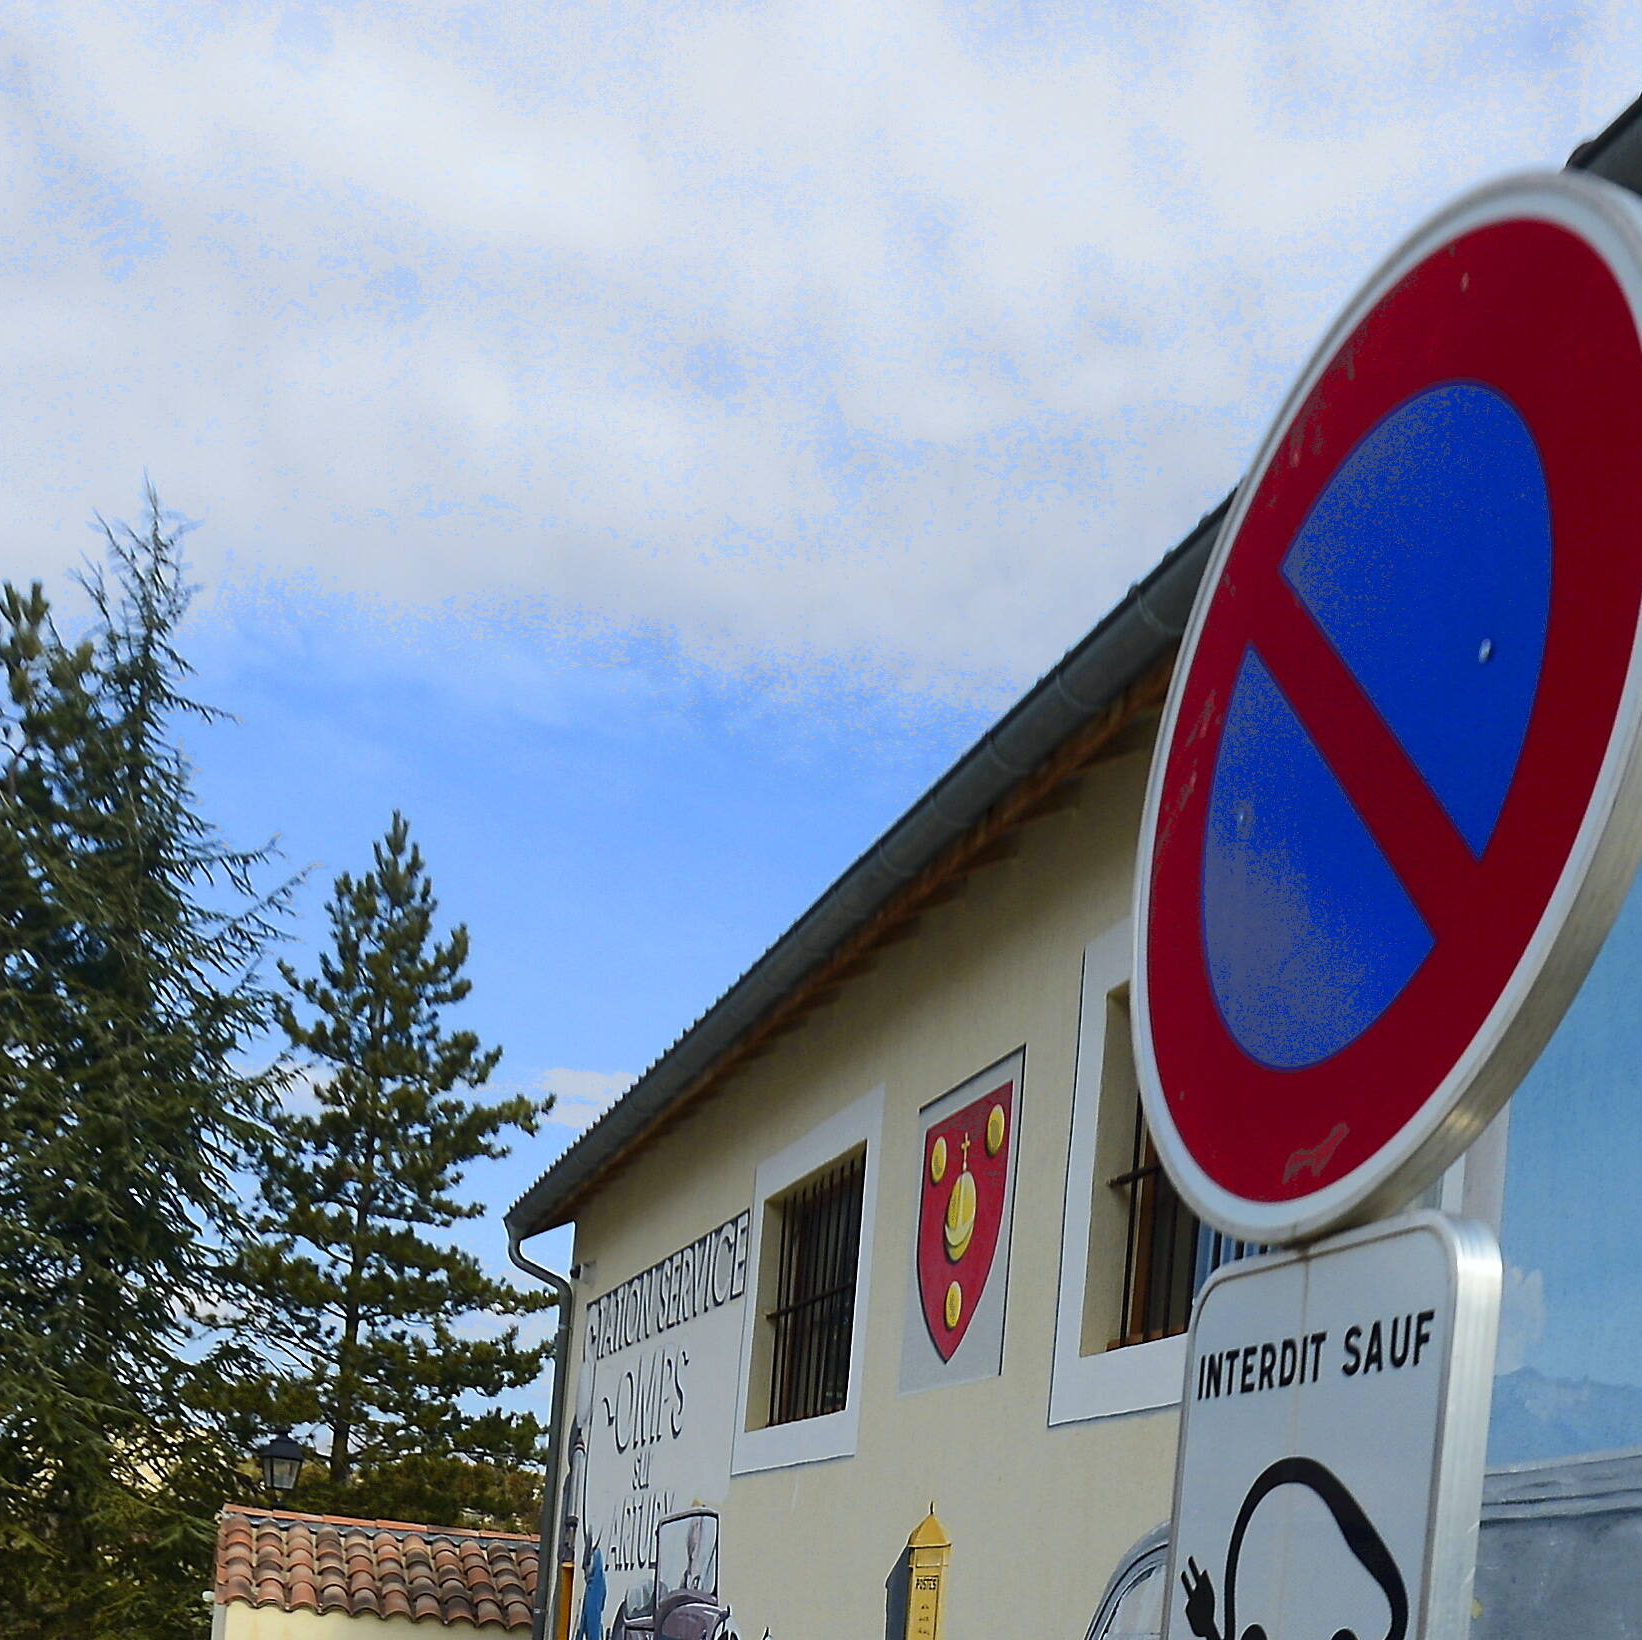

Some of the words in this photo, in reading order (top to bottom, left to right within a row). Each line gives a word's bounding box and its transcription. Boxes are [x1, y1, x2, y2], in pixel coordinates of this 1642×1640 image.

[583, 1267, 657, 1362] STATION
[657, 1210, 750, 1333] SERVICE
[1197, 1330, 1328, 1401] INTERDIT
[1341, 1308, 1436, 1378] SAUF
[632, 1450, 653, 1490] sur
